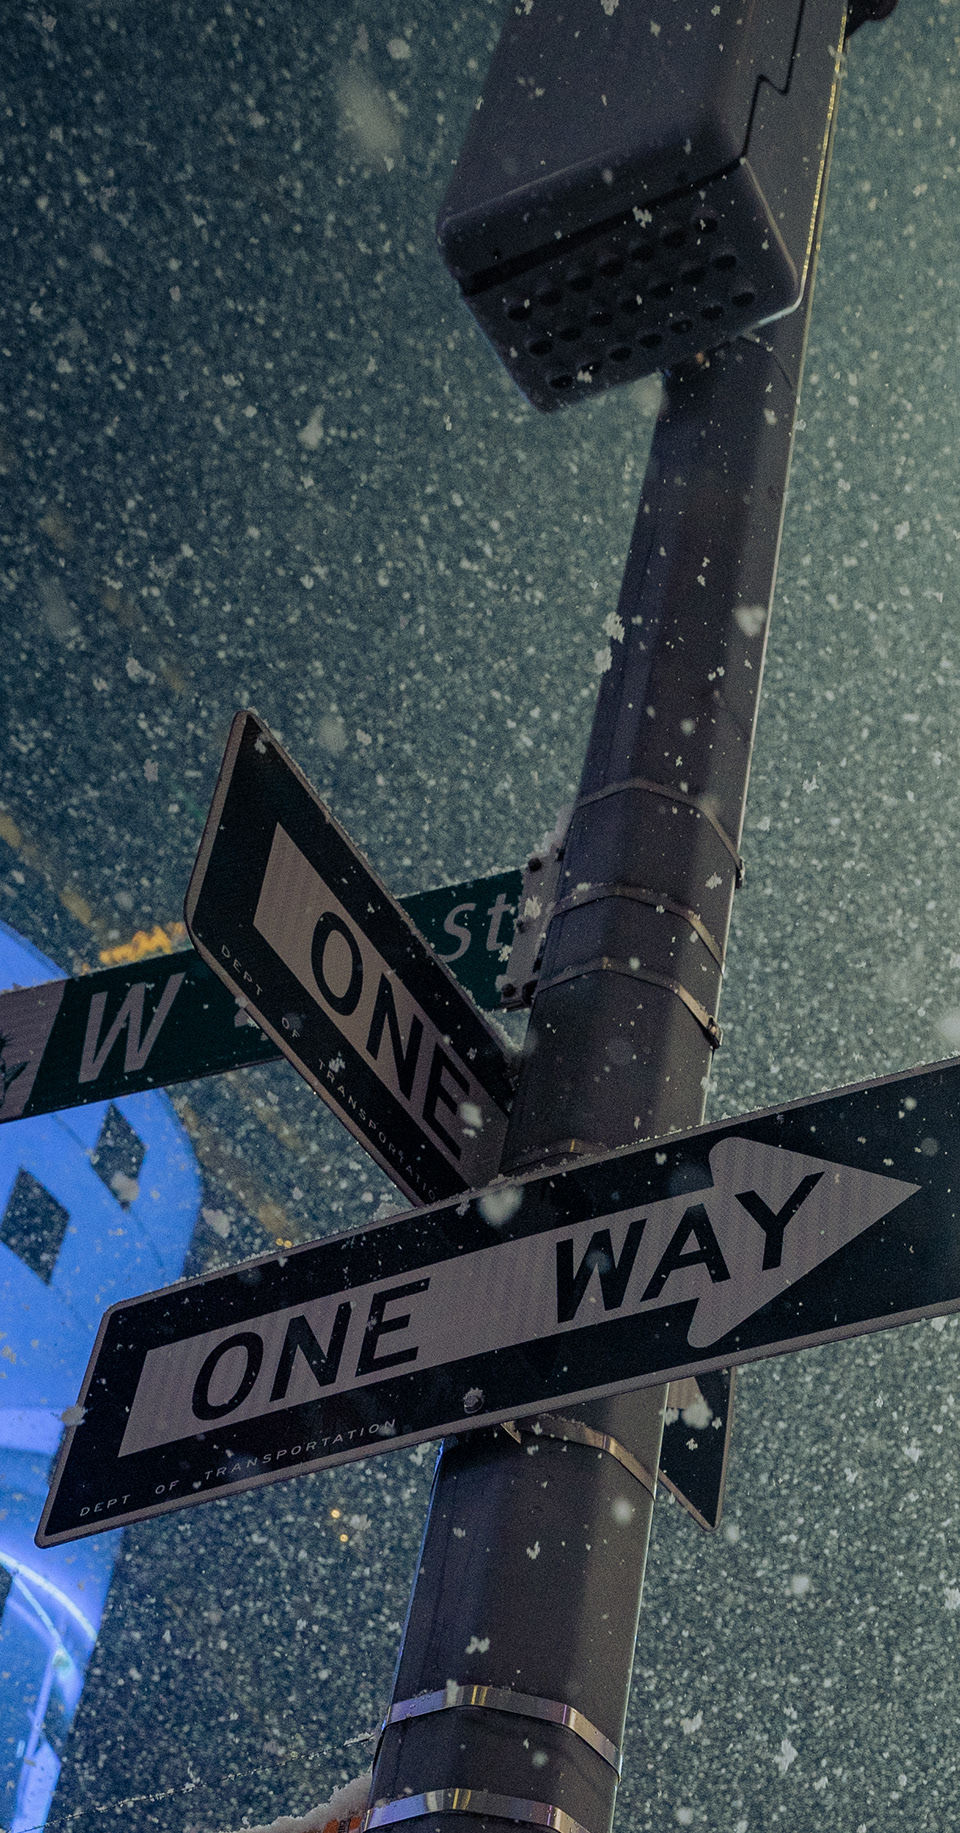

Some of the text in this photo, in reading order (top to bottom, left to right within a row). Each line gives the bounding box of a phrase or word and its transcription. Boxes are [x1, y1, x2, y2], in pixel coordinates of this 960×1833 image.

[78, 972, 187, 1084] W
[436, 893, 512, 963] St
[221, 944, 264, 997] DEPT
[281, 1017, 301, 1039] OF
[318, 1058, 436, 1201] TRANSPORTATIO
[310, 909, 484, 1163] ONE
[190, 1170, 826, 1422] ONE WAY
[79, 1418, 397, 1517] DEPT OF TRANSPORTATION
